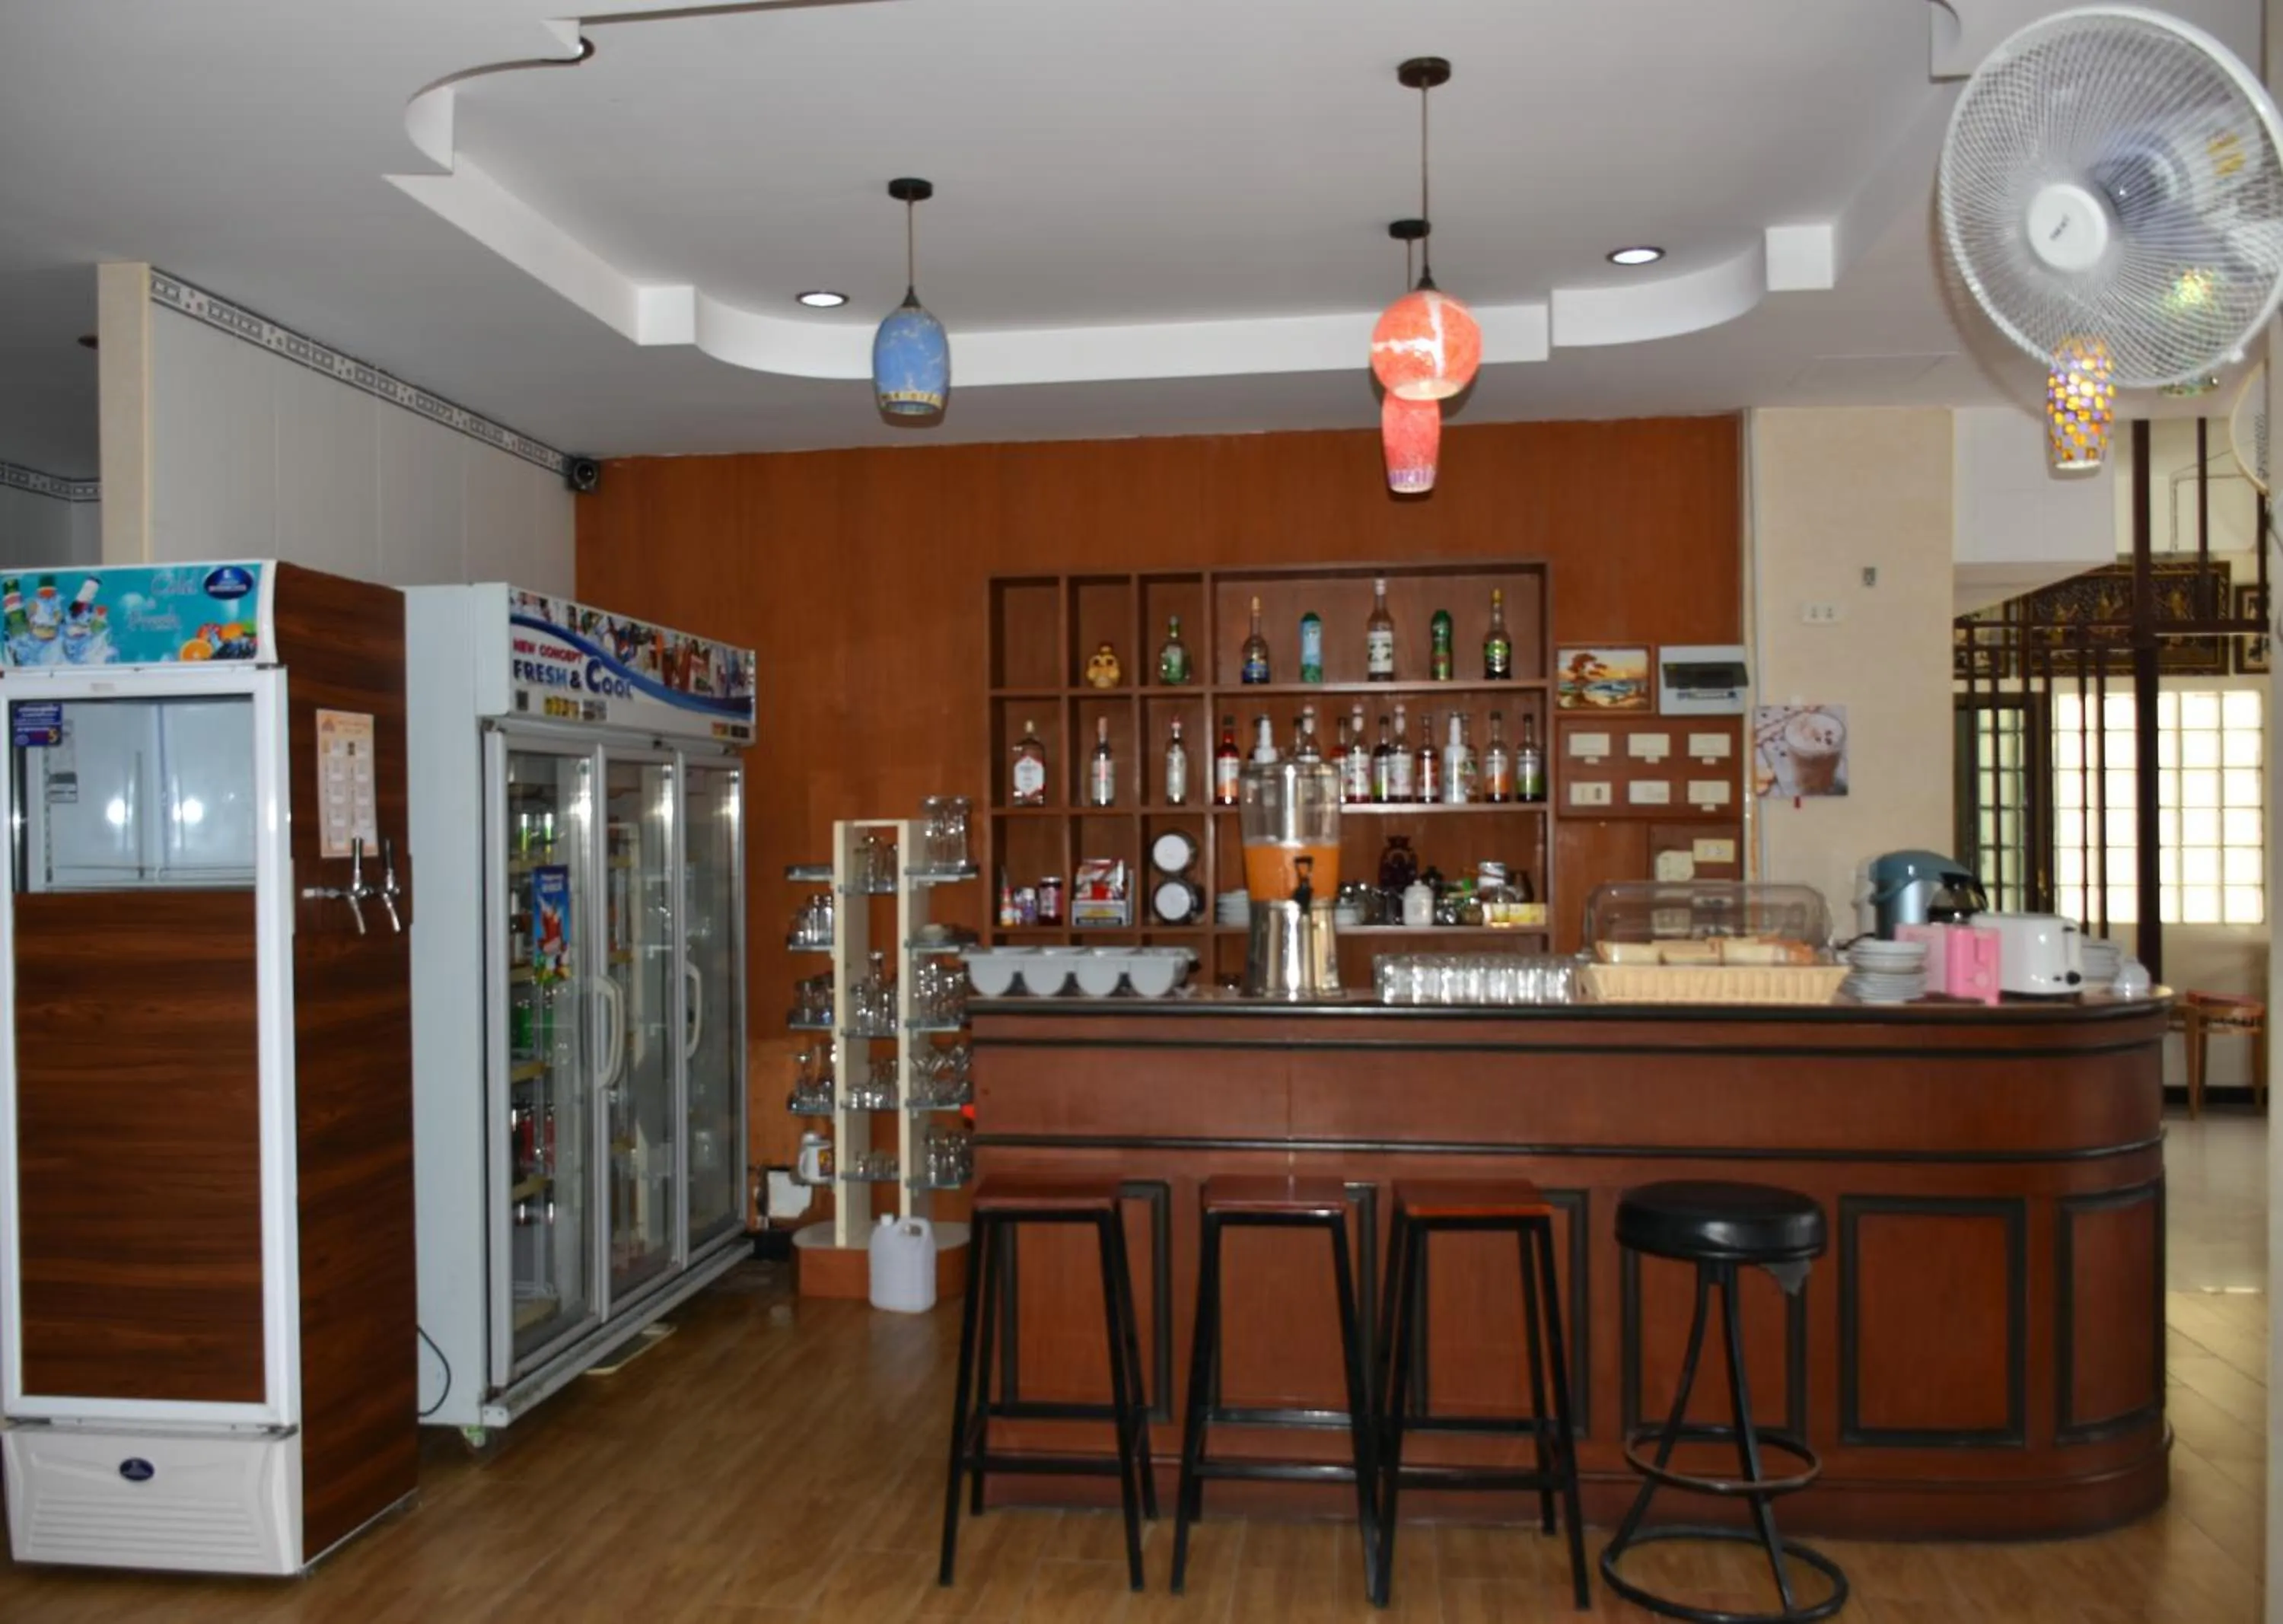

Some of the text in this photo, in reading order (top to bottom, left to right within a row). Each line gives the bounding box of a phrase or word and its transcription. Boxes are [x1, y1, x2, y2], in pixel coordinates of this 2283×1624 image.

[513, 638, 584, 663] NEW CONCEPT
[513, 659, 567, 686] FRESH
[570, 670, 581, 689] &
